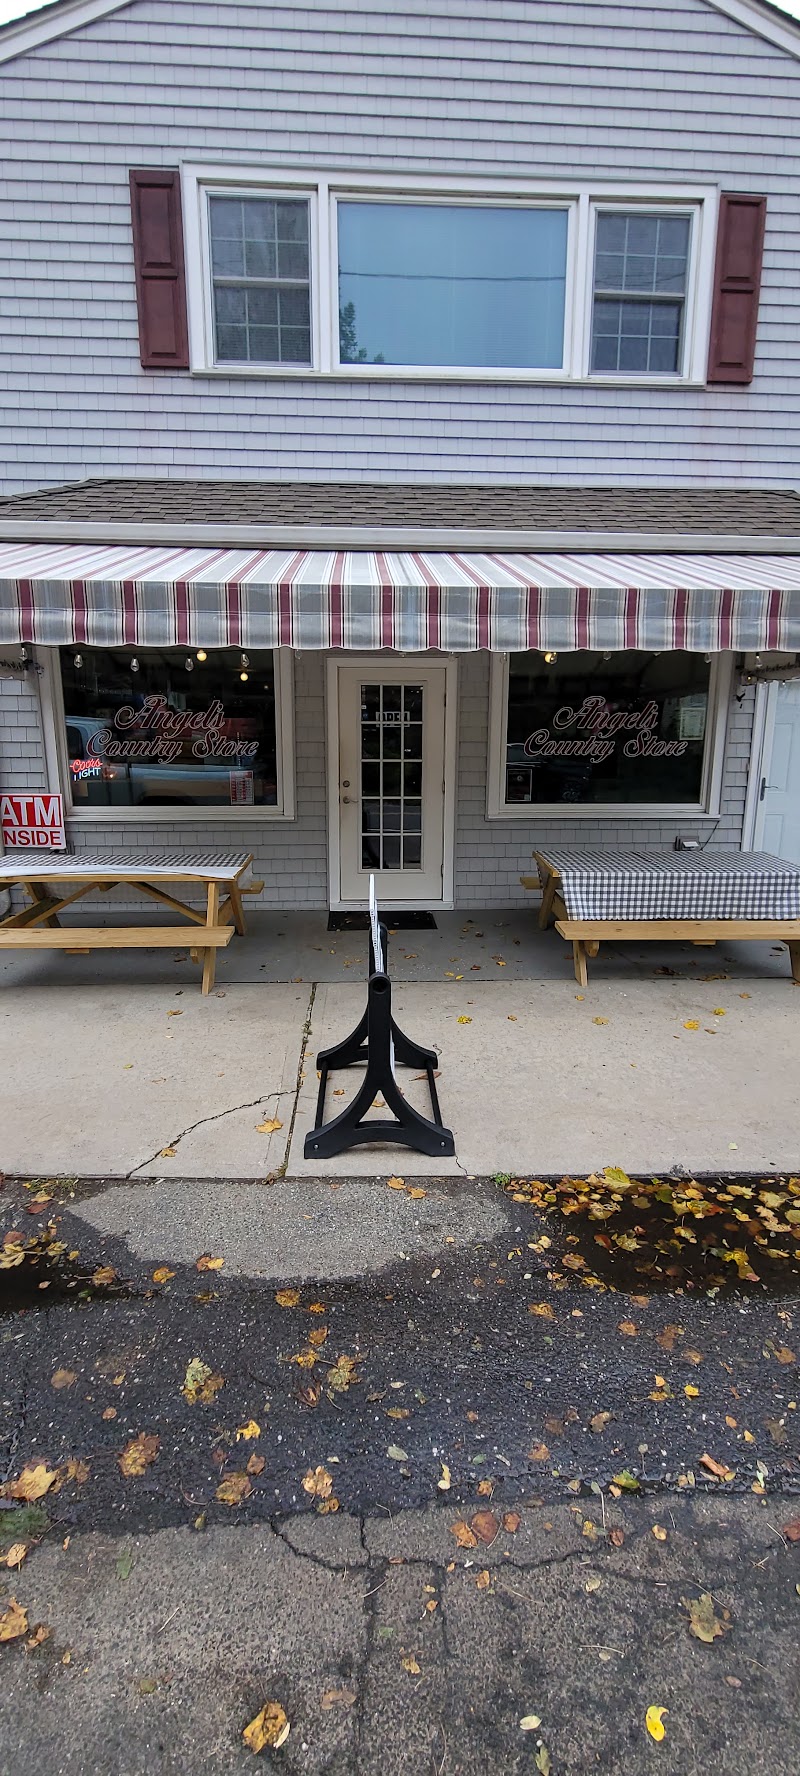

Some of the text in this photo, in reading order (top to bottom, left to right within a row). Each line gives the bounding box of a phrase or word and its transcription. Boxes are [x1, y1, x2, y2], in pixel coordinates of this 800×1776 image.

[85, 728, 260, 764] Country Store
[523, 728, 689, 764] Country Store
[70, 758, 103, 773] Coors
[0, 796, 61, 826] ATM
[3, 830, 62, 846] NSIDE
